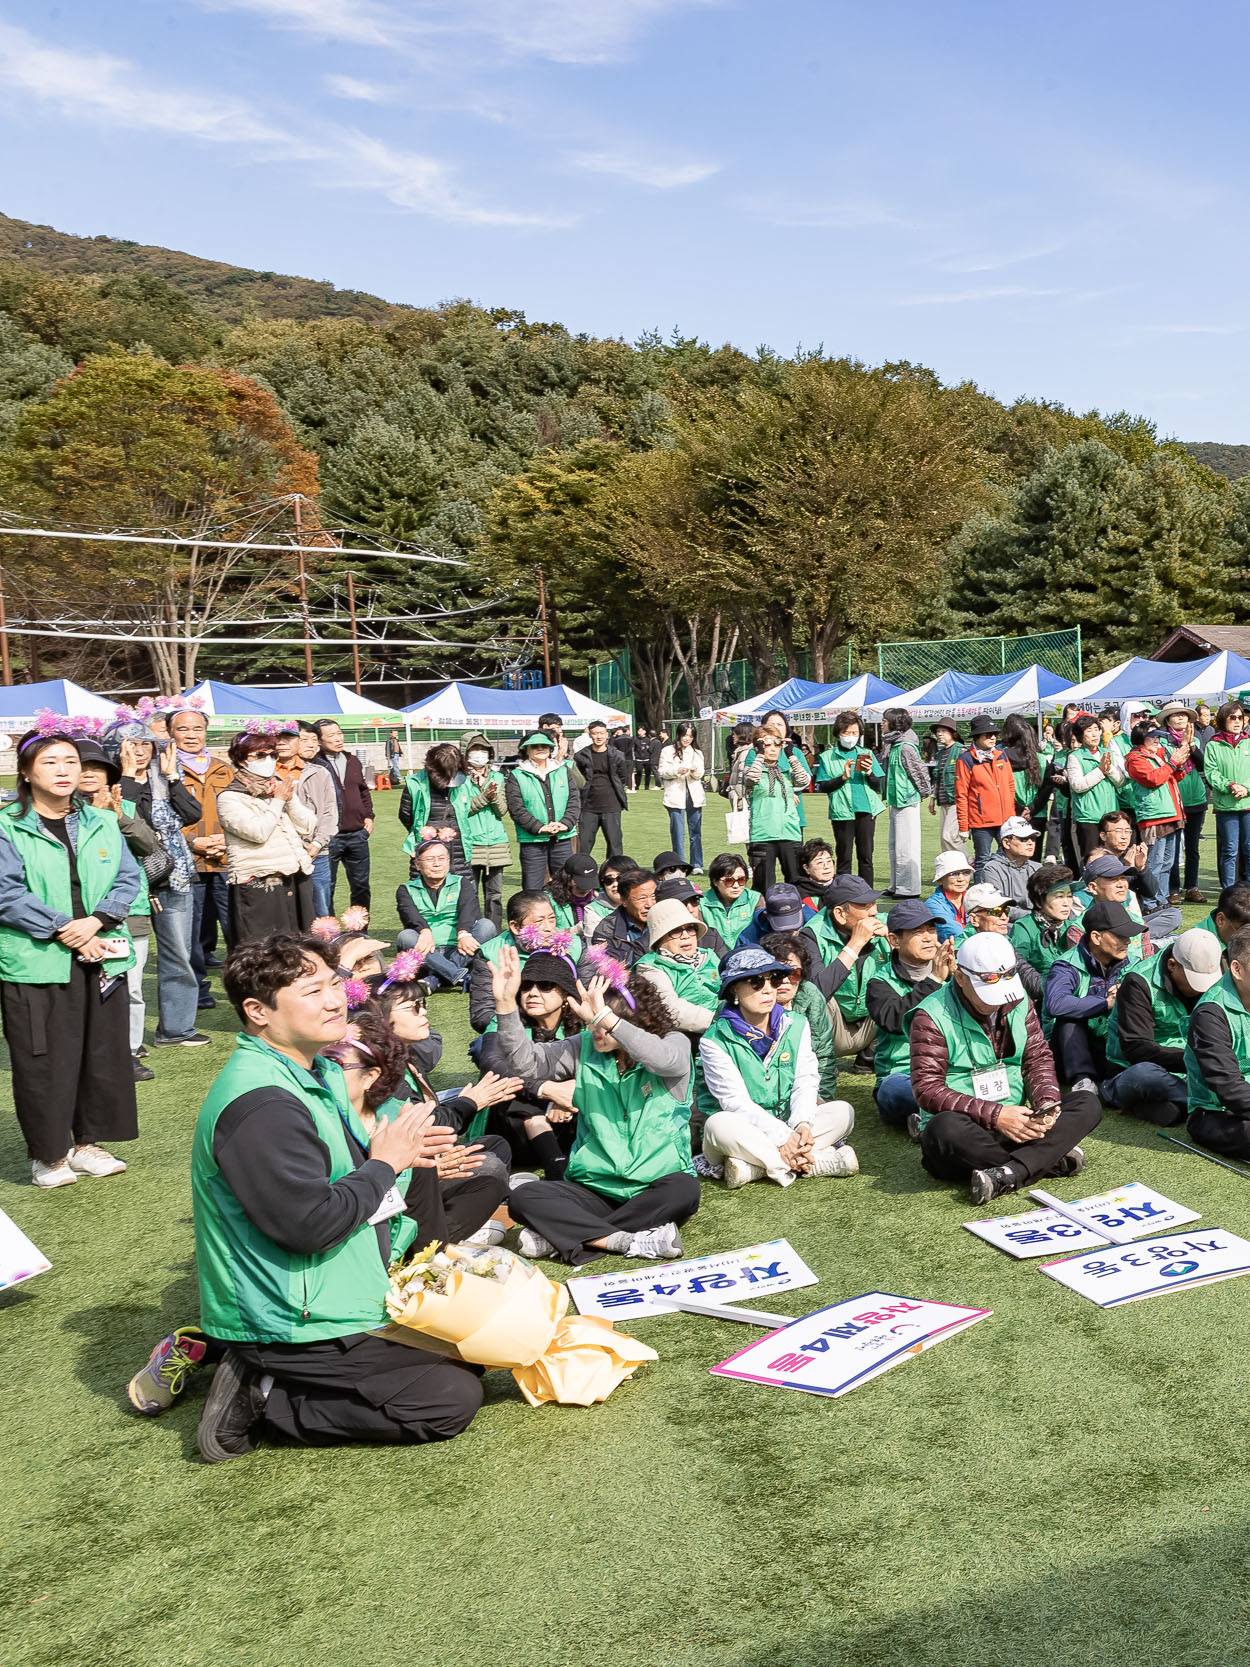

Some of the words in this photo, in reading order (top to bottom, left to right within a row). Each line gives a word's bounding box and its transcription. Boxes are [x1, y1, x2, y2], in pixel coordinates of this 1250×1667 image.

[1082, 1239, 1228, 1278] 자양3동
[596, 1261, 789, 1308] 자양4동
[767, 1301, 923, 1373] 자양제4동
